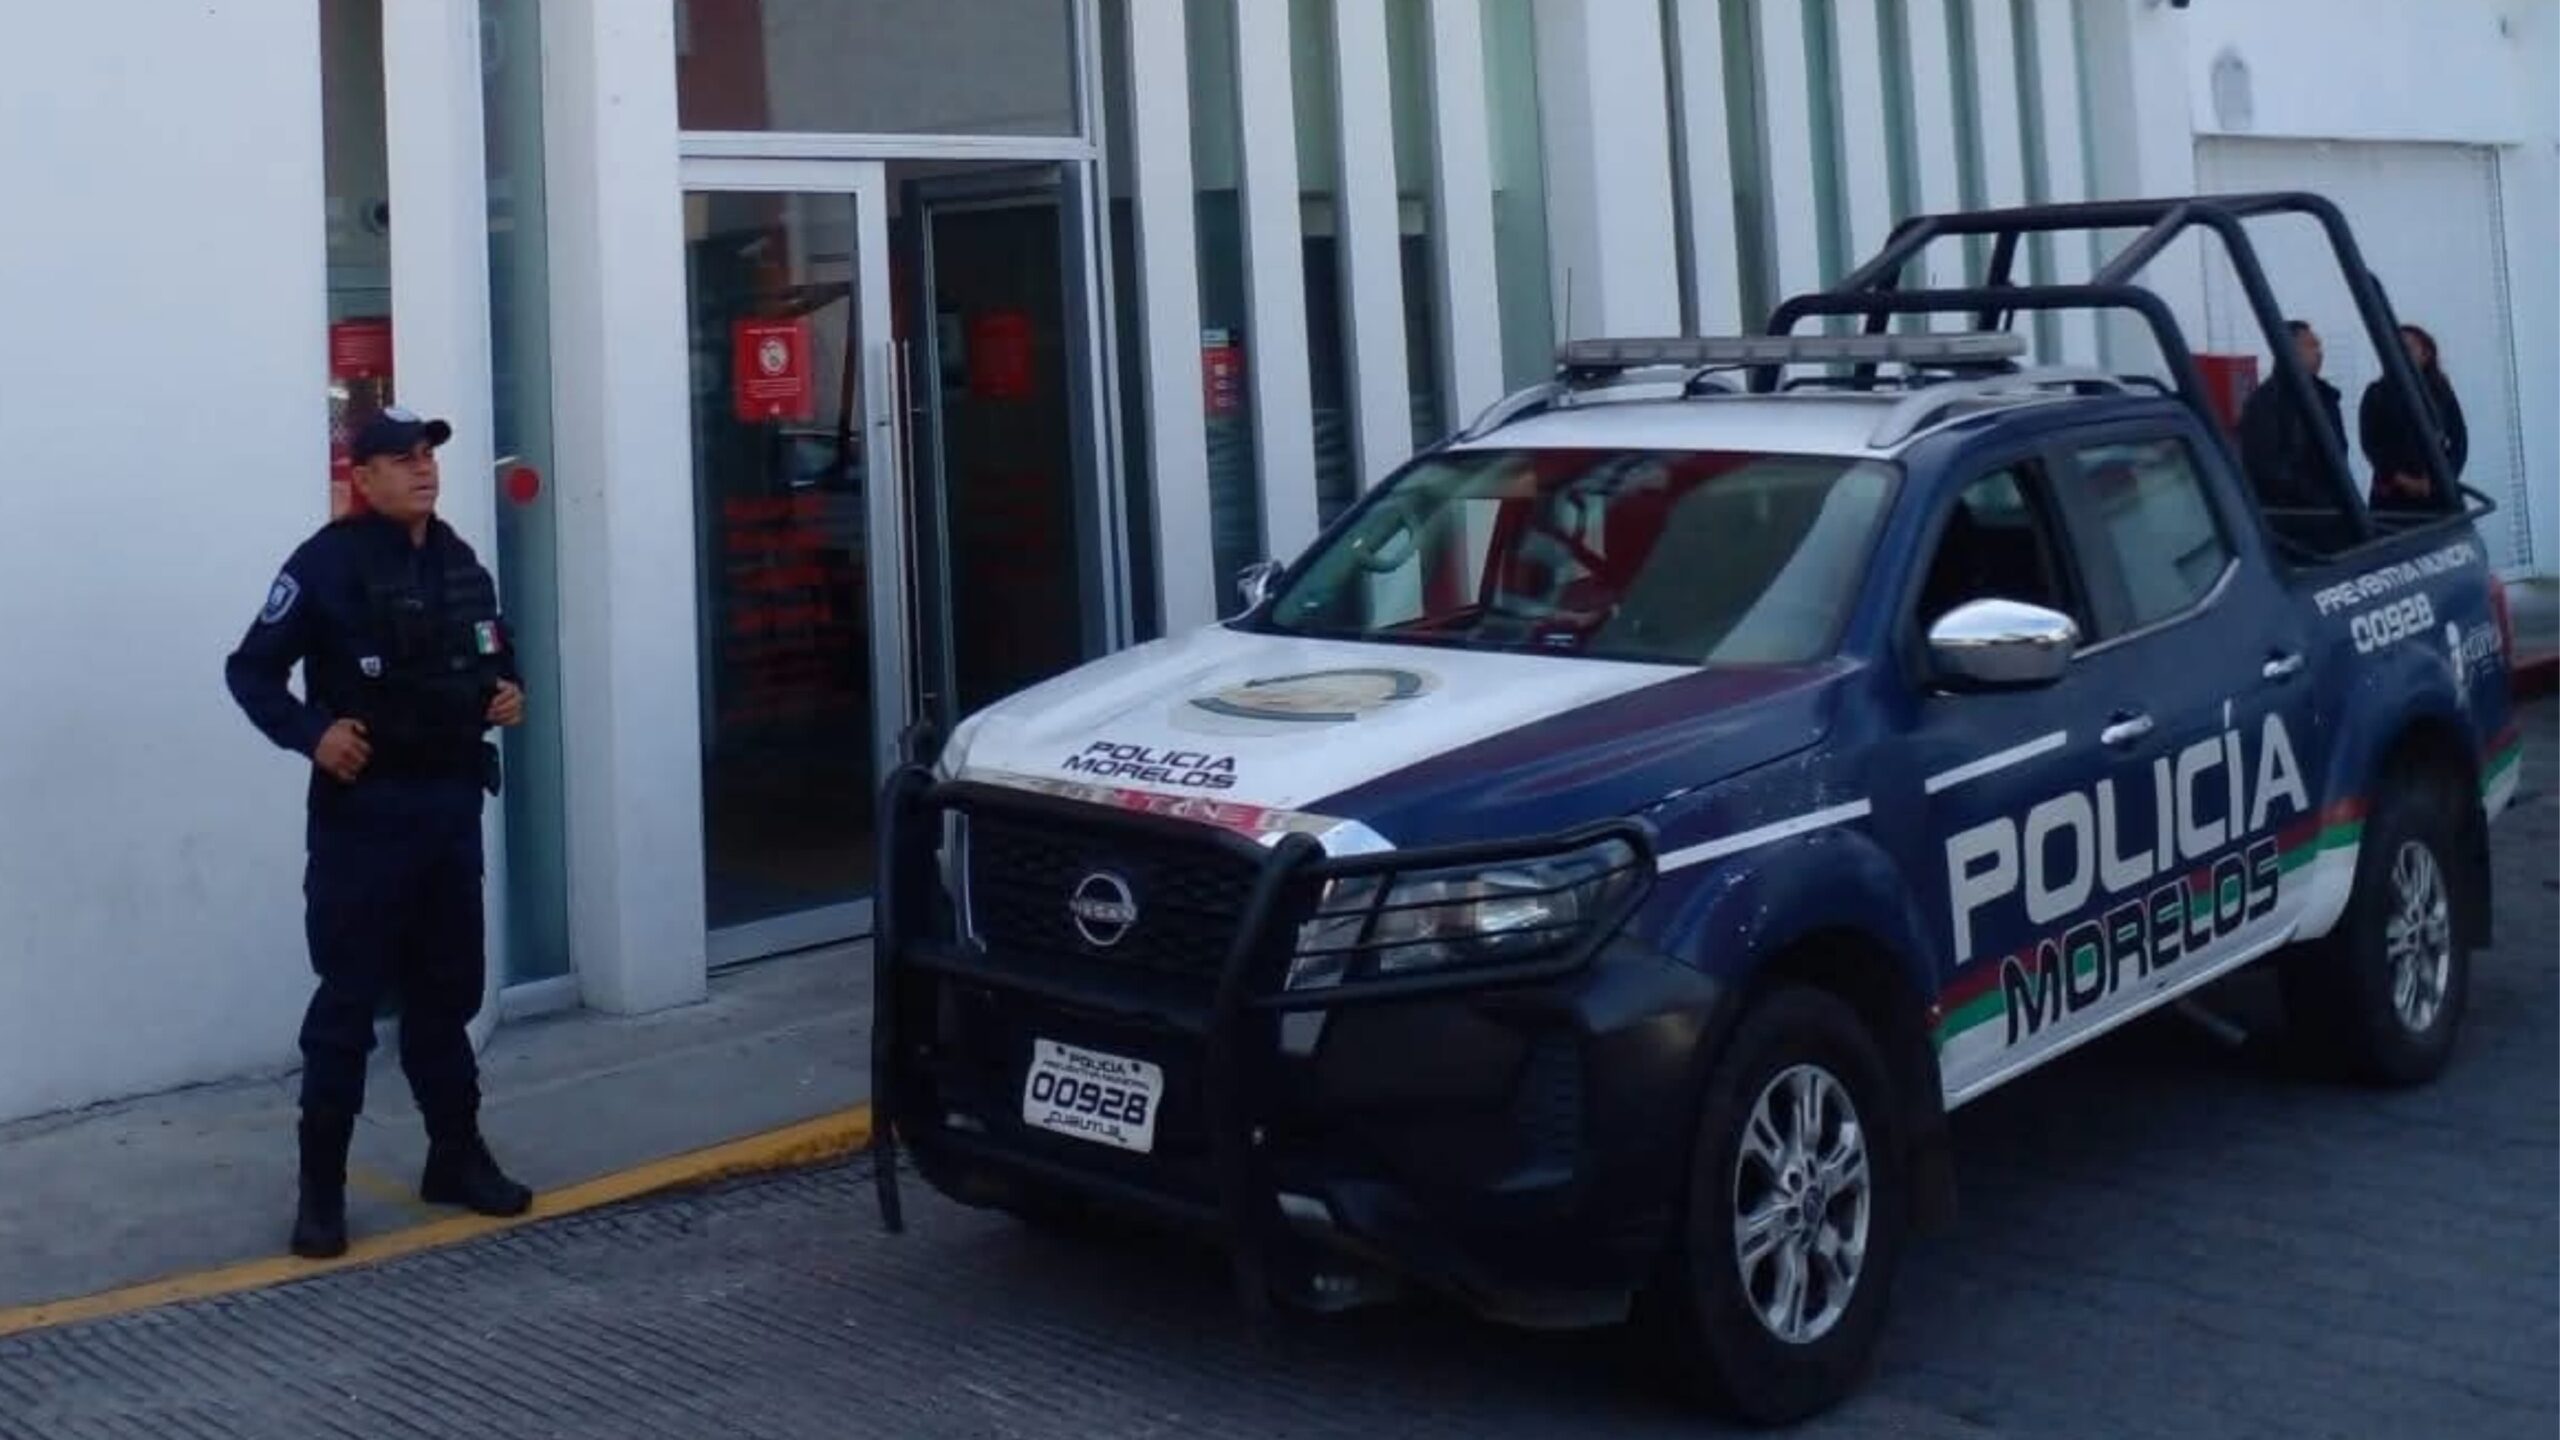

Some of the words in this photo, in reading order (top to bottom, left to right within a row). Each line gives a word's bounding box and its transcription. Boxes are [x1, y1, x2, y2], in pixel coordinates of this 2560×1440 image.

[2313, 562, 2420, 617] PREVENTIVA
[2350, 591, 2436, 655] 00928
[1062, 755, 1238, 789] MORELOS
[1083, 740, 1237, 773] POLICIA
[1945, 699, 2309, 966] POLICÍA
[2000, 834, 2280, 1047] MORELOS
[1032, 1071, 1148, 1126] 00928
